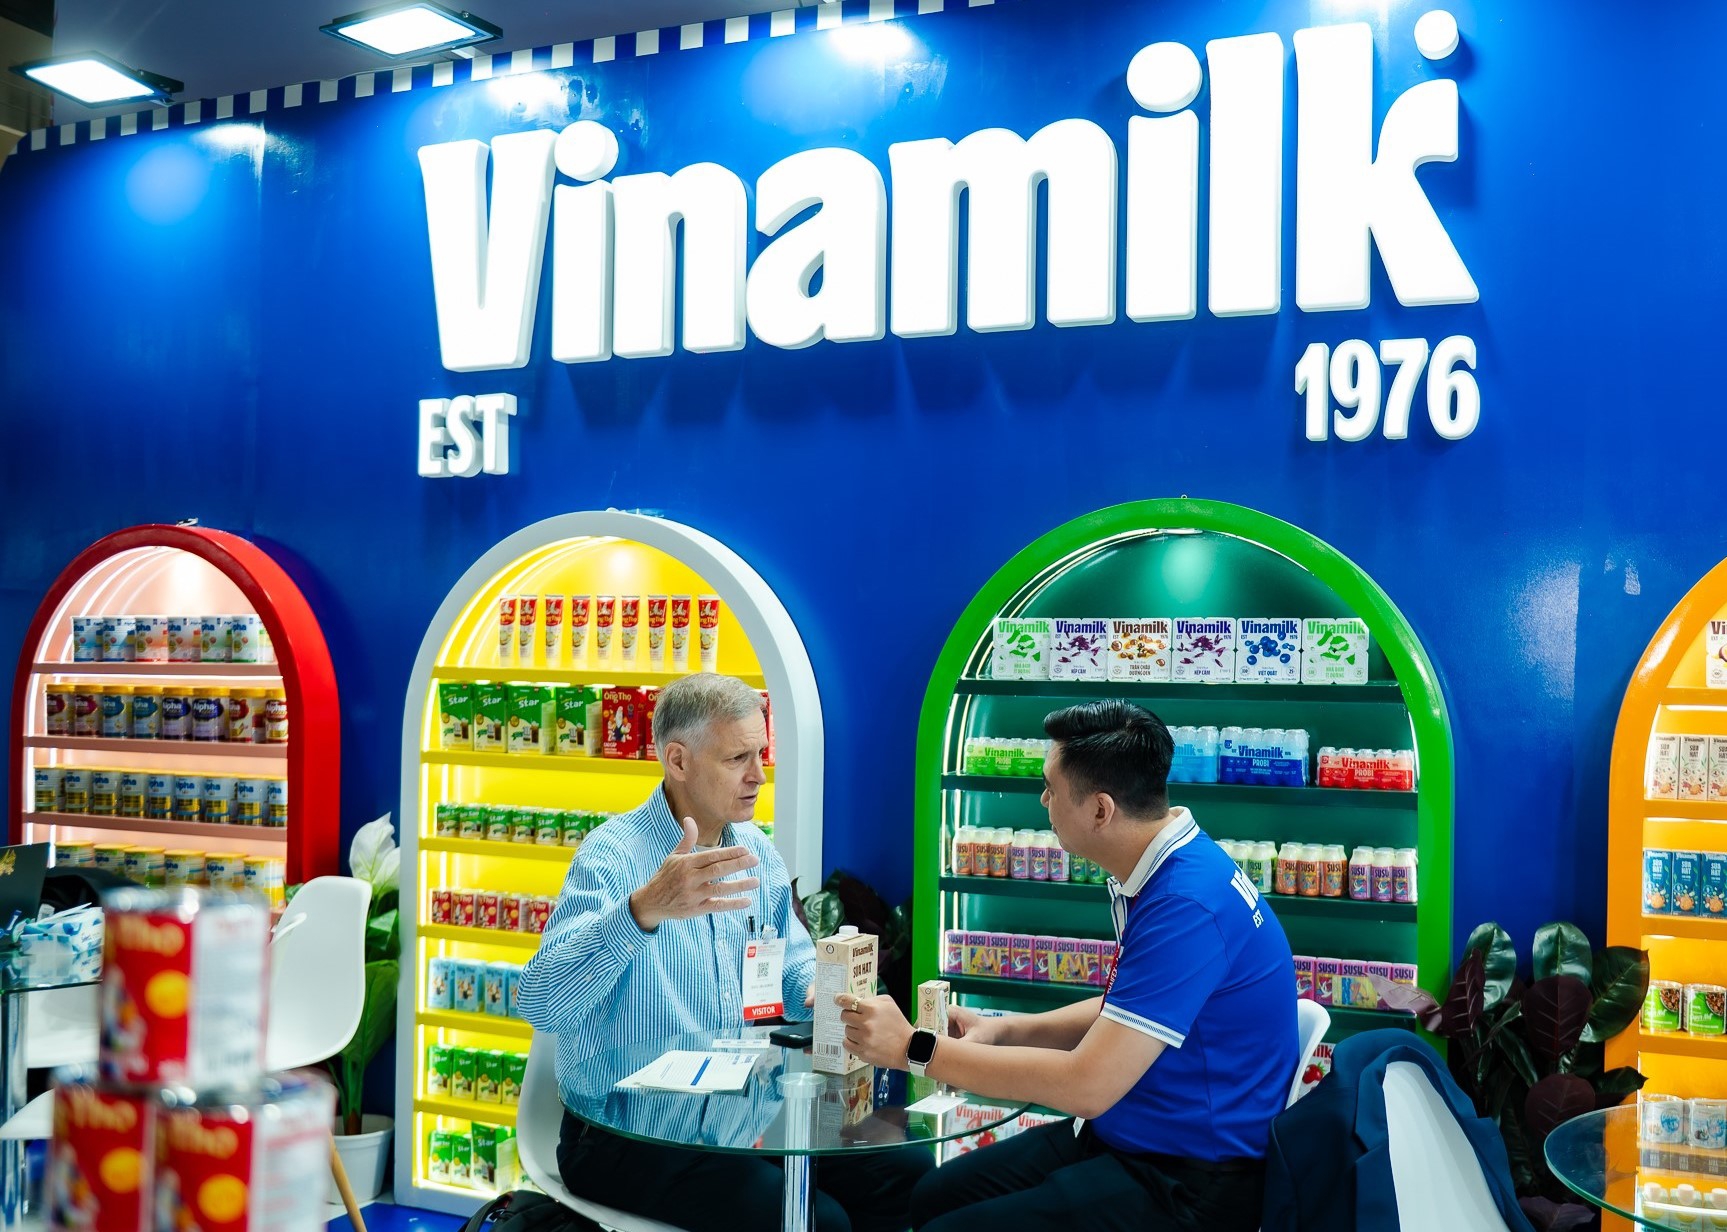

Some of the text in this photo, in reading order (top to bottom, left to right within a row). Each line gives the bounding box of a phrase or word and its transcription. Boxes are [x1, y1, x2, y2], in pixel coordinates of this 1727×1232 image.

[418, 9, 1479, 372] Vinamilk
[417, 335, 1480, 478] EST 1976
[999, 621, 1050, 634] Vinamilk
[1056, 620, 1106, 634] Vinamilk
[1113, 620, 1168, 634] Vinamilk
[1177, 620, 1232, 634] Vinamilk
[1241, 620, 1298, 634] Vinamilk
[1308, 621, 1366, 634] Vinamilk
[448, 696, 468, 706] Star
[482, 697, 502, 707] Star
[518, 700, 540, 709] Star
[564, 701, 584, 710] Star
[1238, 745, 1284, 758] Vinamilk
[1252, 758, 1270, 767] PROBI
[1342, 757, 1390, 770] Vinamilk
[1354, 768, 1374, 776] PROBI
[969, 935, 986, 945] SUSU
[991, 937, 1008, 947] SUSU
[1013, 938, 1030, 948] SUSU
[1036, 940, 1053, 950] SUSU
[1058, 942, 1074, 952] SUSU
[1081, 943, 1098, 954] SUSU
[1103, 945, 1116, 955] SUS
[1318, 963, 1337, 974] SUSU
[1344, 965, 1363, 976] SUSU
[1394, 968, 1414, 980] SUSU
[752, 1006, 776, 1016] VISITOR
[956, 1106, 1004, 1120] Vinamilk
[478, 1138, 495, 1148] Star
